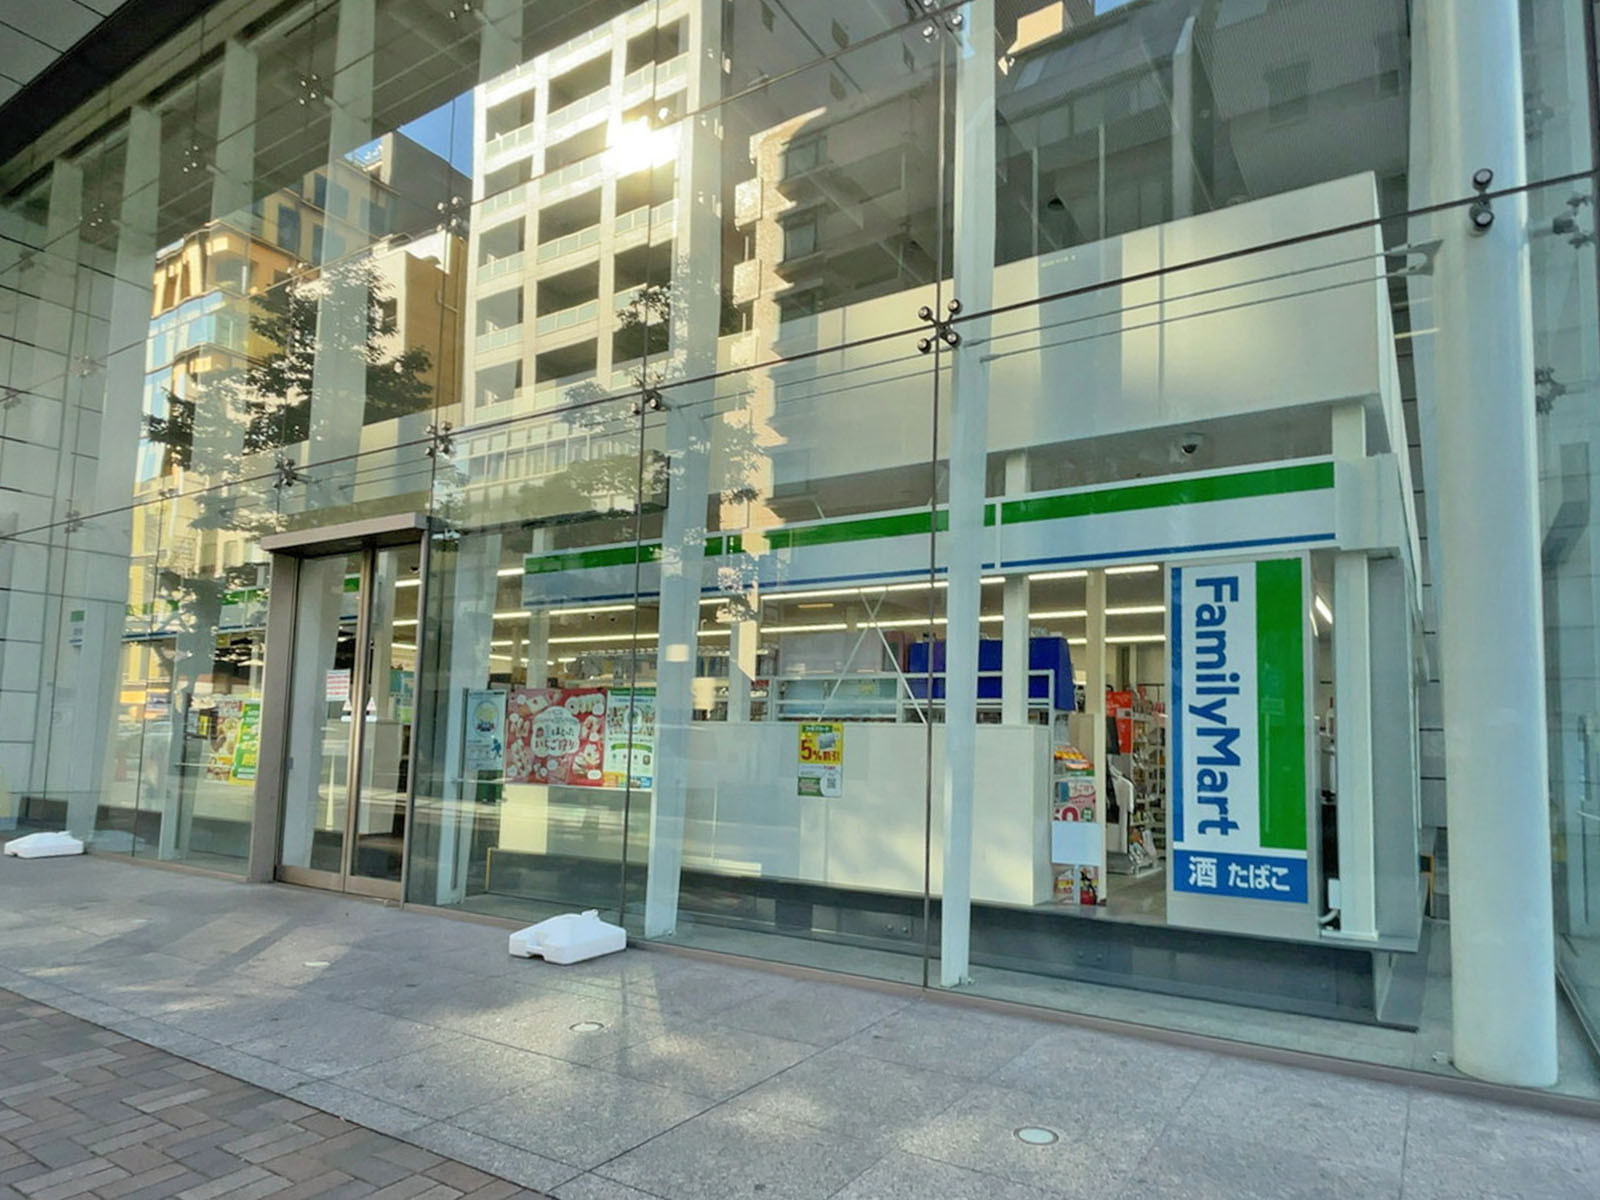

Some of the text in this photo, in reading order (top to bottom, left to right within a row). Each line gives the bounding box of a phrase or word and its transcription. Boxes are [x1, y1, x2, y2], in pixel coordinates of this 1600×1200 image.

[1188, 576, 1241, 836] FamilyMart
[1188, 856, 1291, 892] 酒 たばこ
